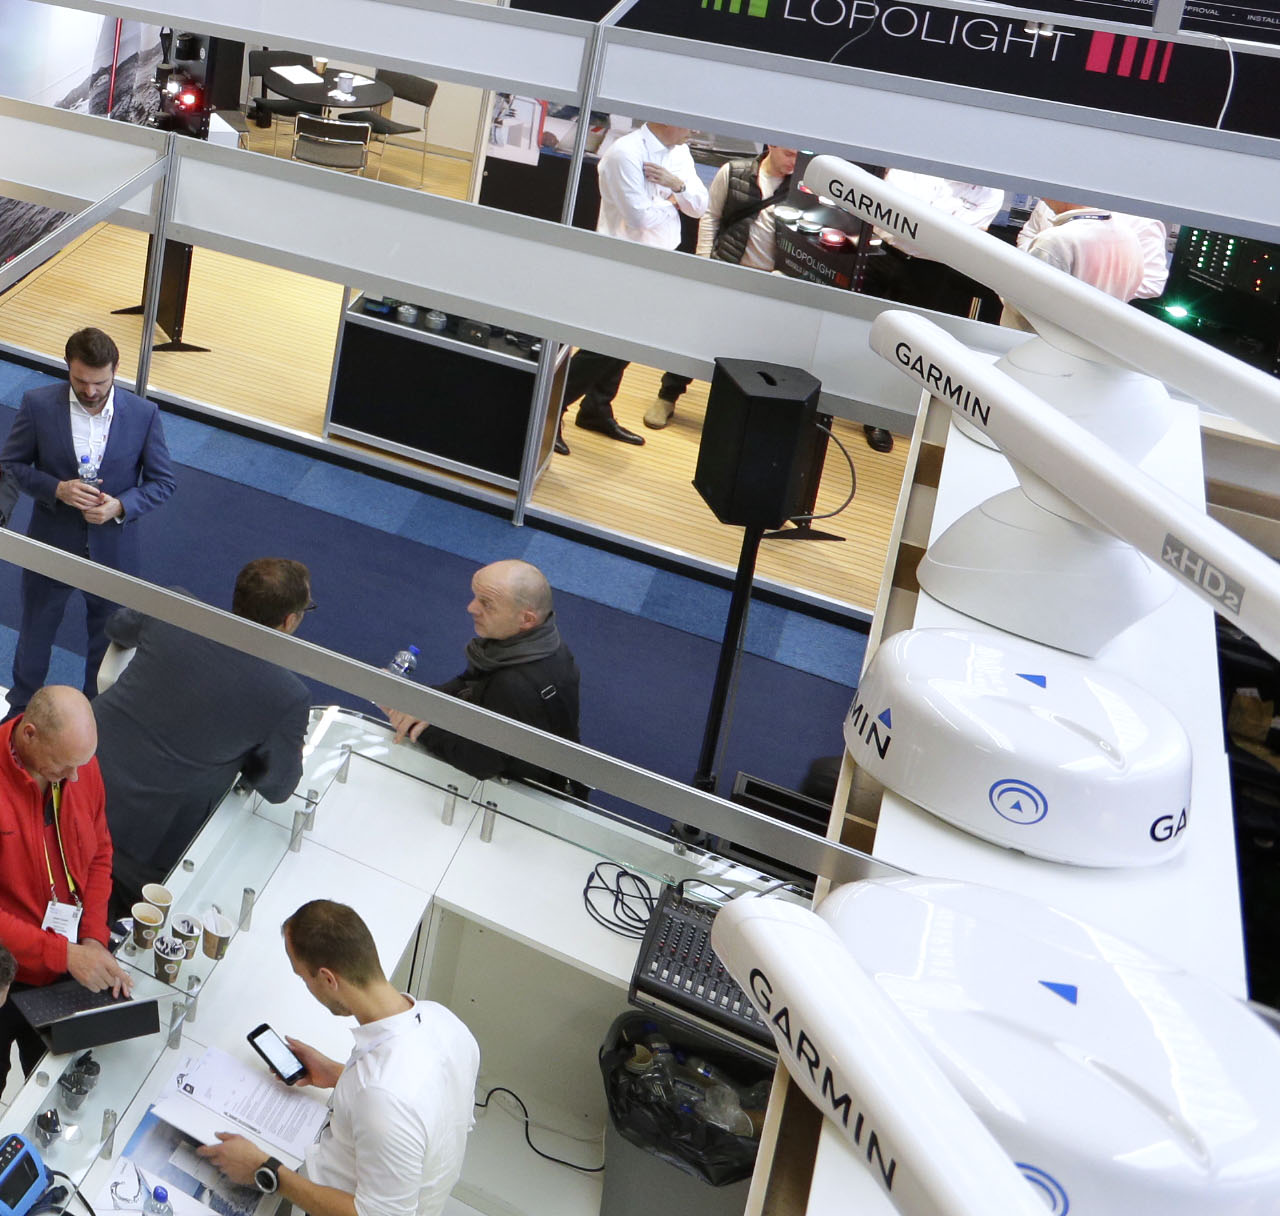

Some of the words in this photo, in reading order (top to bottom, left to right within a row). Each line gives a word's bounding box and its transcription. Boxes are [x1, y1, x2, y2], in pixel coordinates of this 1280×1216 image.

[1184, 4, 1220, 16] PPROVAL
[828, 178, 920, 240] GARMIN
[791, 245, 837, 280] LOPOLIGHT
[895, 342, 991, 426] GARMIN
[848, 693, 892, 761] MIN
[749, 967, 897, 1192] GARMIN
